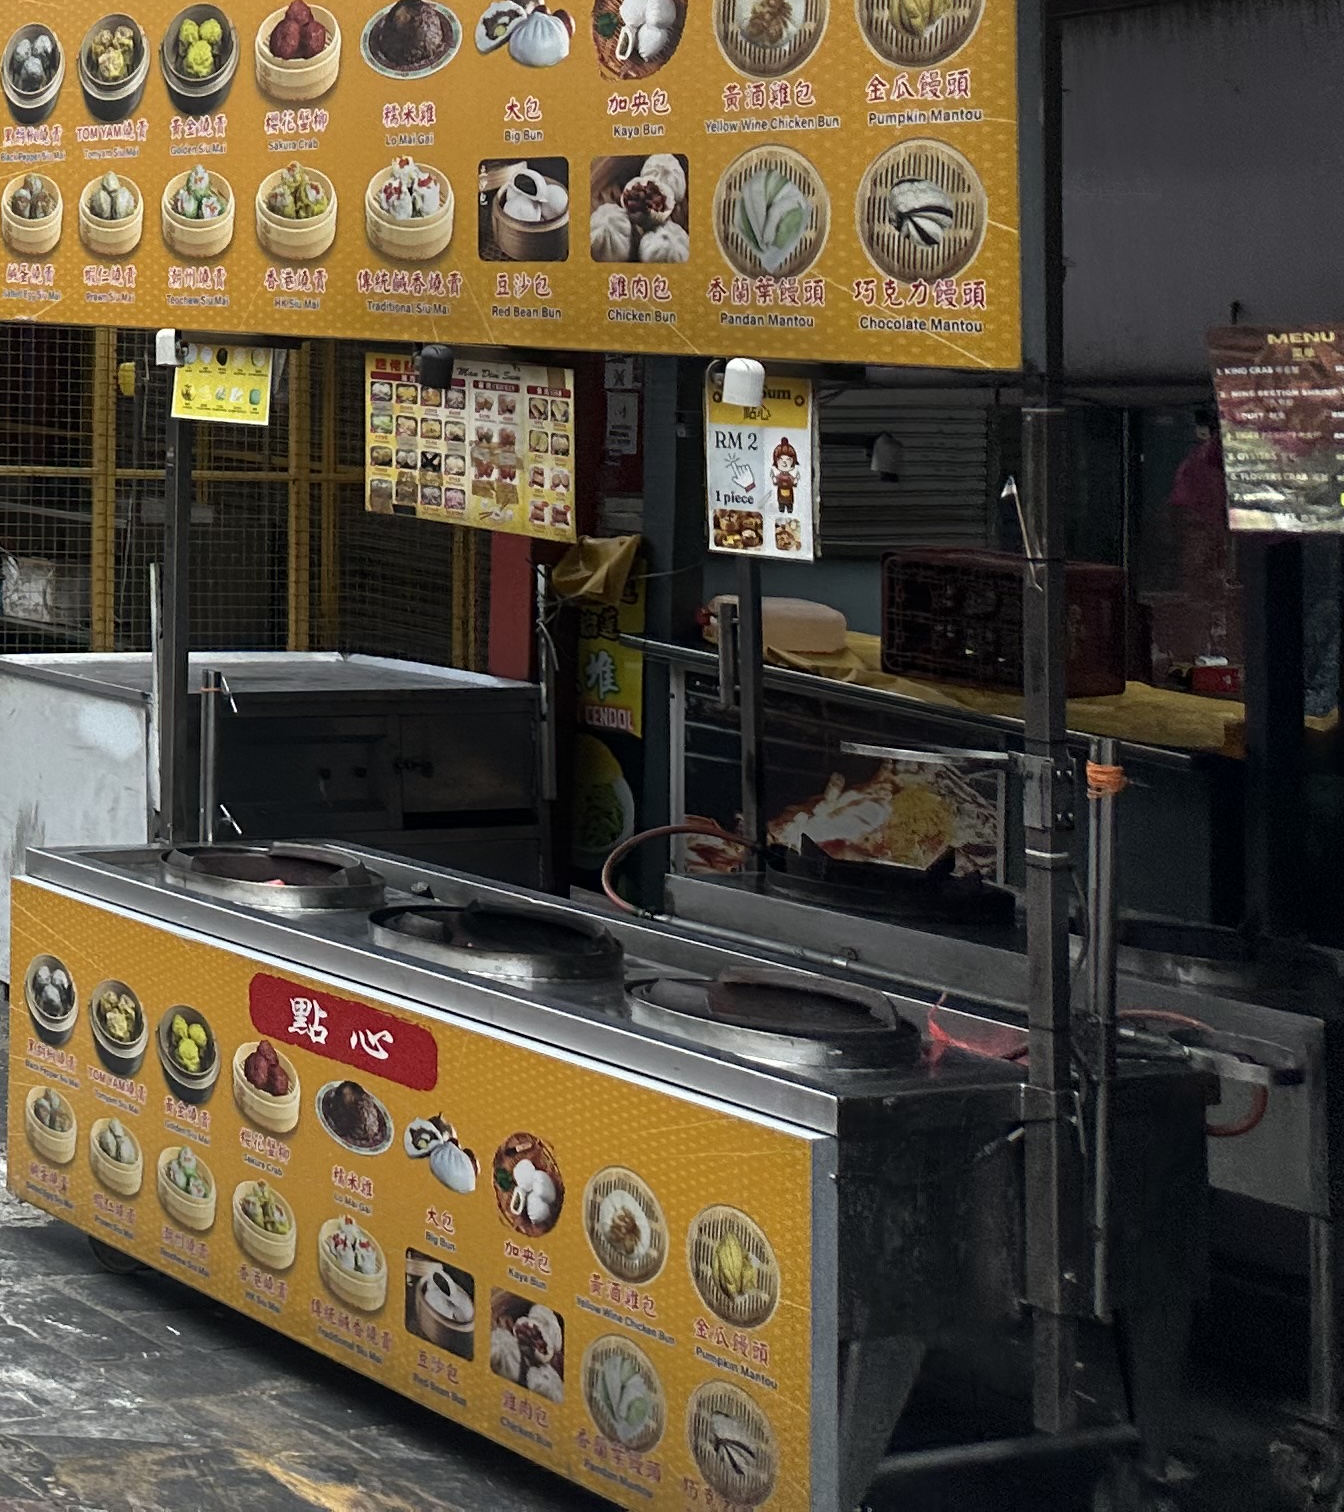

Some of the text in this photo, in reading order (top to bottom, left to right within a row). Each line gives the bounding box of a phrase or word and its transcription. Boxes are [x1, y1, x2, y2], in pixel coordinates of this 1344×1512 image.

[504, 94, 543, 123] 大包
[606, 88, 672, 118] 加央包
[704, 114, 841, 134] Yellow Wine Chicken Bun
[868, 108, 983, 127] Pumpkin Mantou
[504, 129, 544, 144] Big Bun
[613, 122, 665, 139] Kaya Bun
[267, 137, 320, 152] Sakura Crab
[385, 133, 398, 146] Lo
[398, 133, 415, 146] Mai
[211, 142, 227, 155] Mai
[494, 271, 553, 299] 豆沙包
[607, 273, 672, 302] 雞肉包
[212, 295, 230, 308] Mai
[303, 298, 320, 310] Mai
[366, 299, 412, 314] Traditional
[491, 305, 562, 320] Red Bean Bun
[607, 307, 677, 325] Chicken Bun
[720, 313, 815, 328] Pandan Mantou
[859, 316, 984, 333] Chocolate Mantou
[1267, 331, 1336, 345] MENU
[481, 368, 521, 381] Dim Sum
[1248, 366, 1274, 376] CRAB
[714, 430, 759, 451] RM 2
[715, 490, 754, 506] 1 piece
[287, 996, 395, 1061] 點心
[424, 1206, 456, 1235] 大包
[424, 1230, 457, 1253] Big Bun
[503, 1239, 552, 1276] 加央包
[508, 1267, 529, 1285] Kaya
[695, 1345, 778, 1391] Pumpkin Mantou
